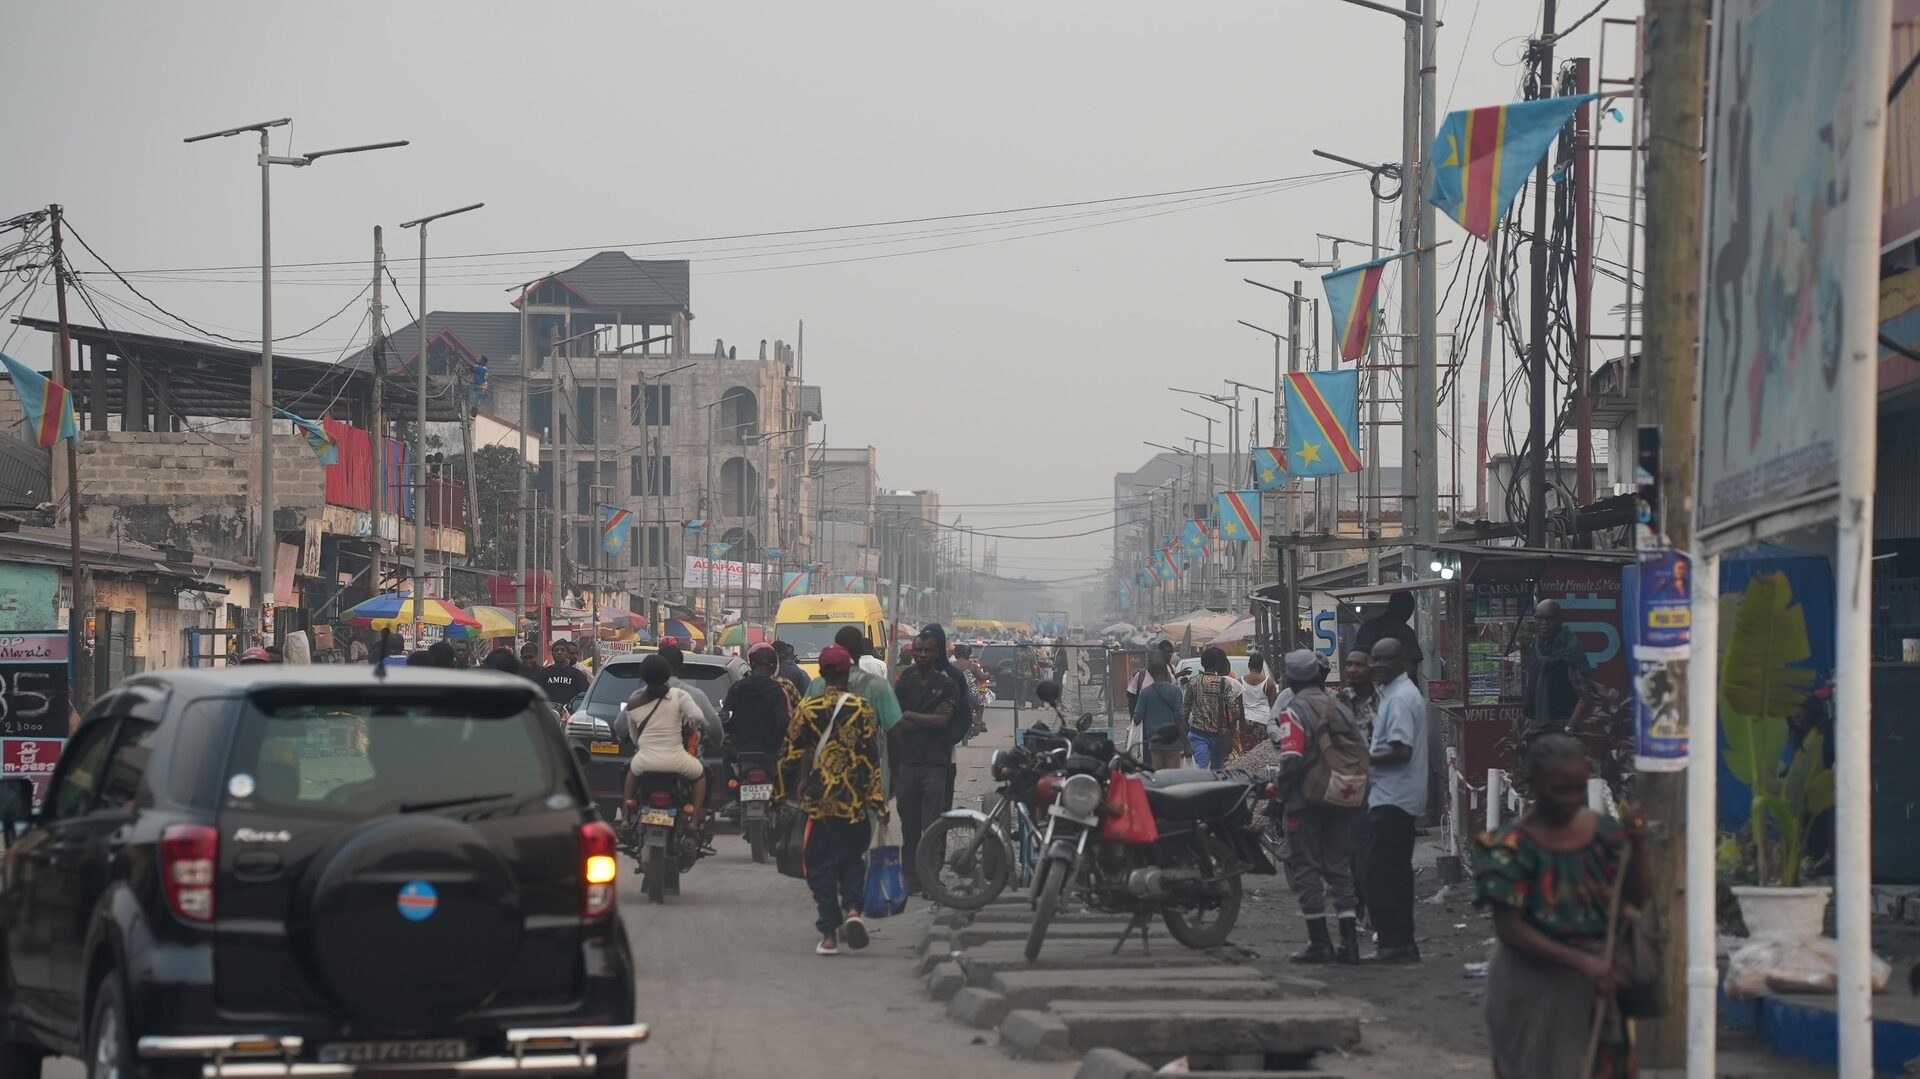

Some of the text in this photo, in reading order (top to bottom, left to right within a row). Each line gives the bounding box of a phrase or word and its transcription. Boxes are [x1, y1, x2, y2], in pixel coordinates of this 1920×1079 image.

[1477, 583, 1529, 595] CAESAR
[610, 642, 632, 652] ABRUTI
[547, 676, 572, 685] AMIRI
[1465, 708, 1496, 721] VENTE
